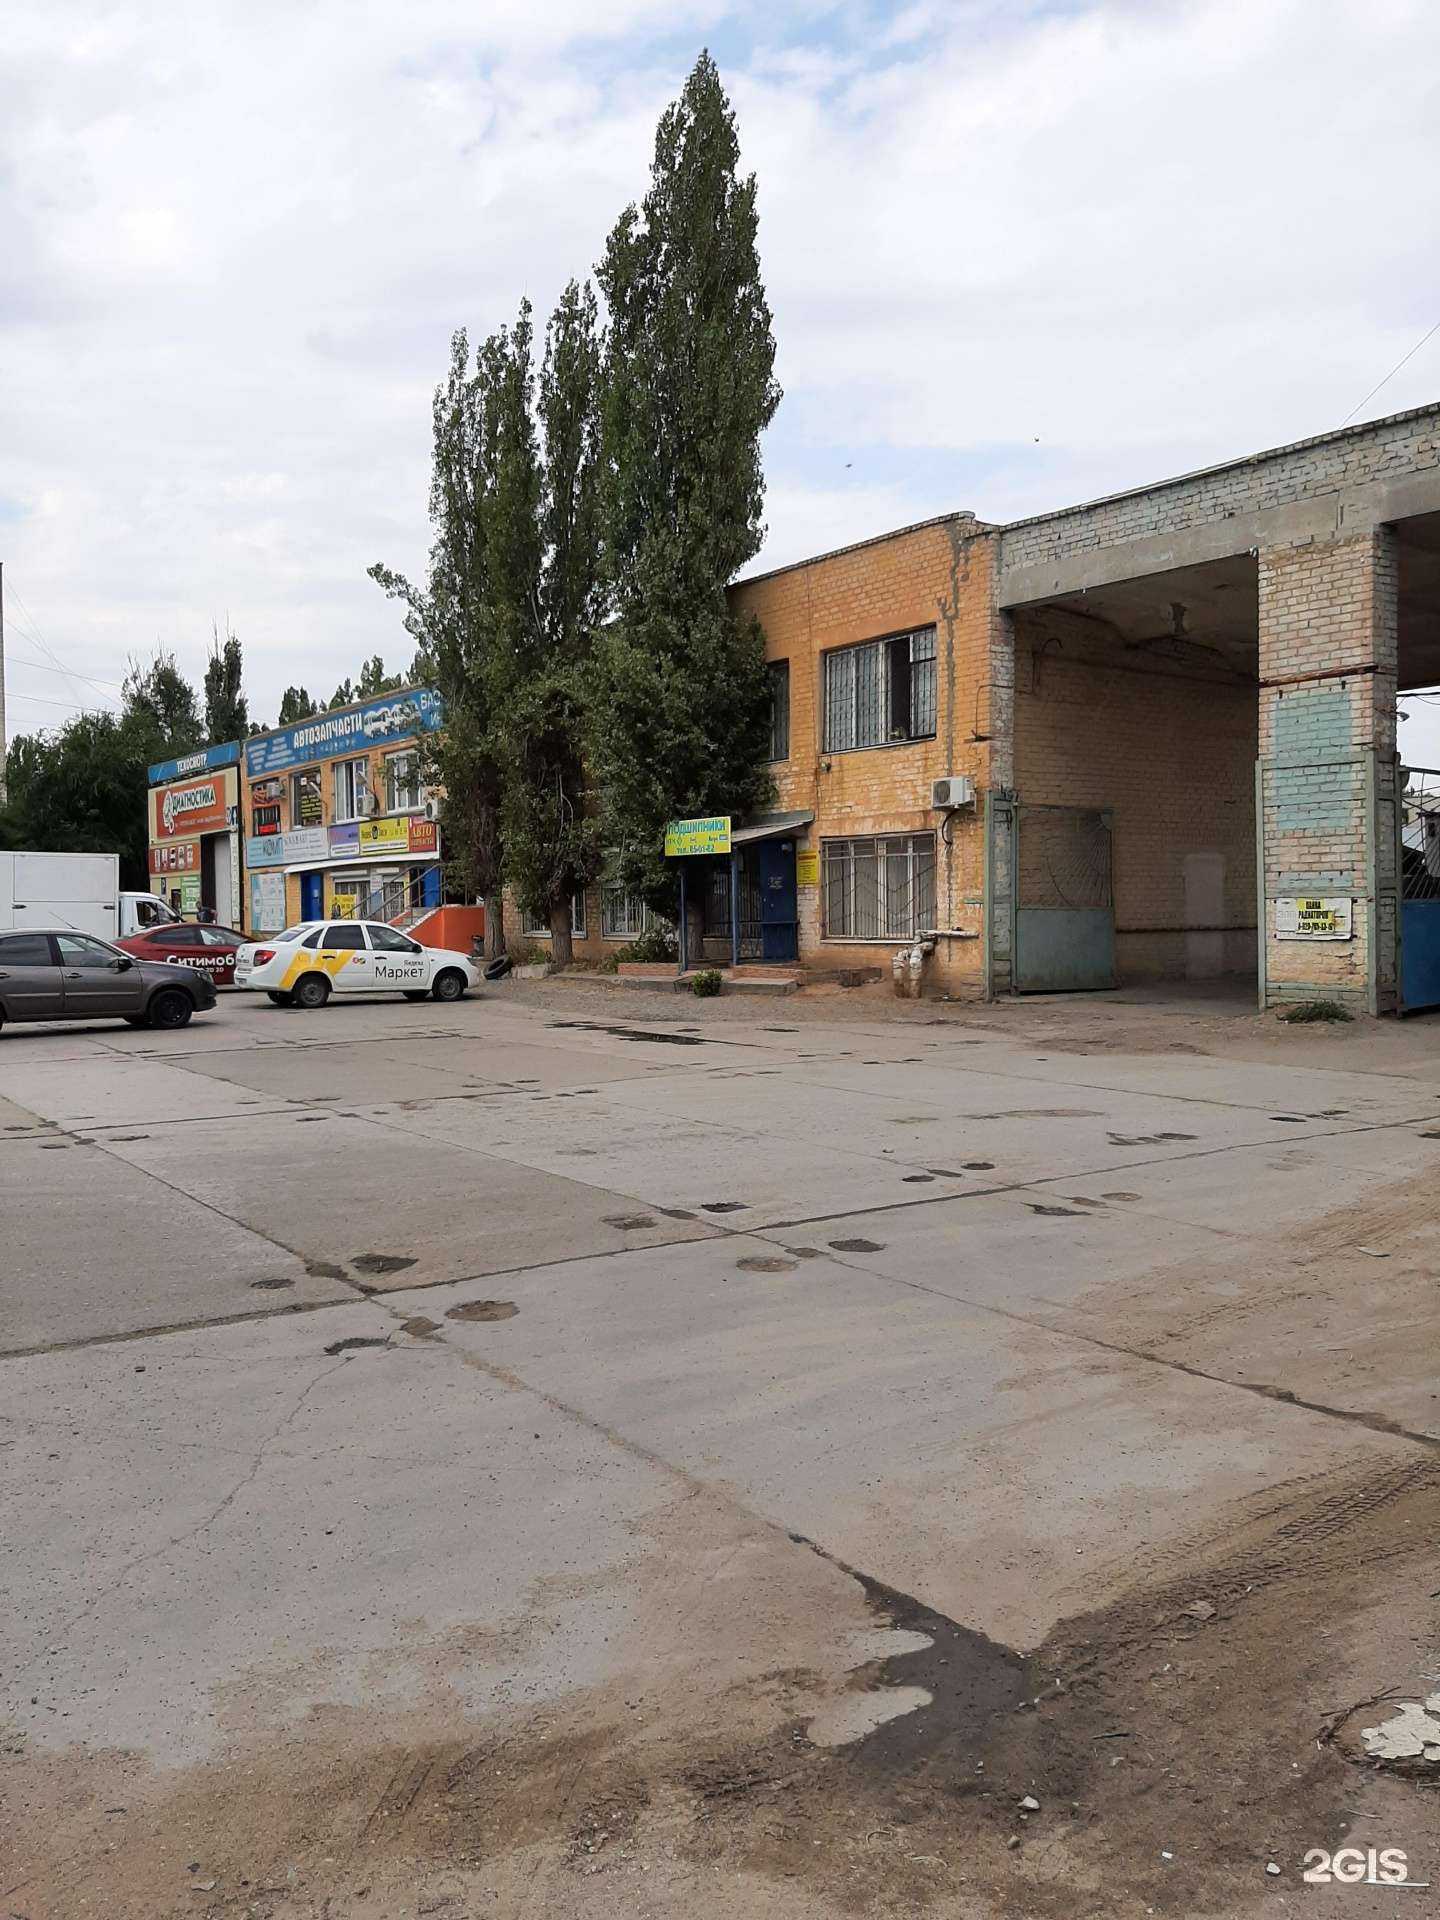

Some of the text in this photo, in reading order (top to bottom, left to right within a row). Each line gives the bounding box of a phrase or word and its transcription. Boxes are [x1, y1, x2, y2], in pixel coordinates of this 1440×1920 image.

[293, 712, 363, 749] АВТОЗАПЧАСТИ
[172, 785, 217, 813] ДИАГНОСТИКА
[413, 823, 432, 838] АВТО
[375, 966, 424, 980] Маркет
